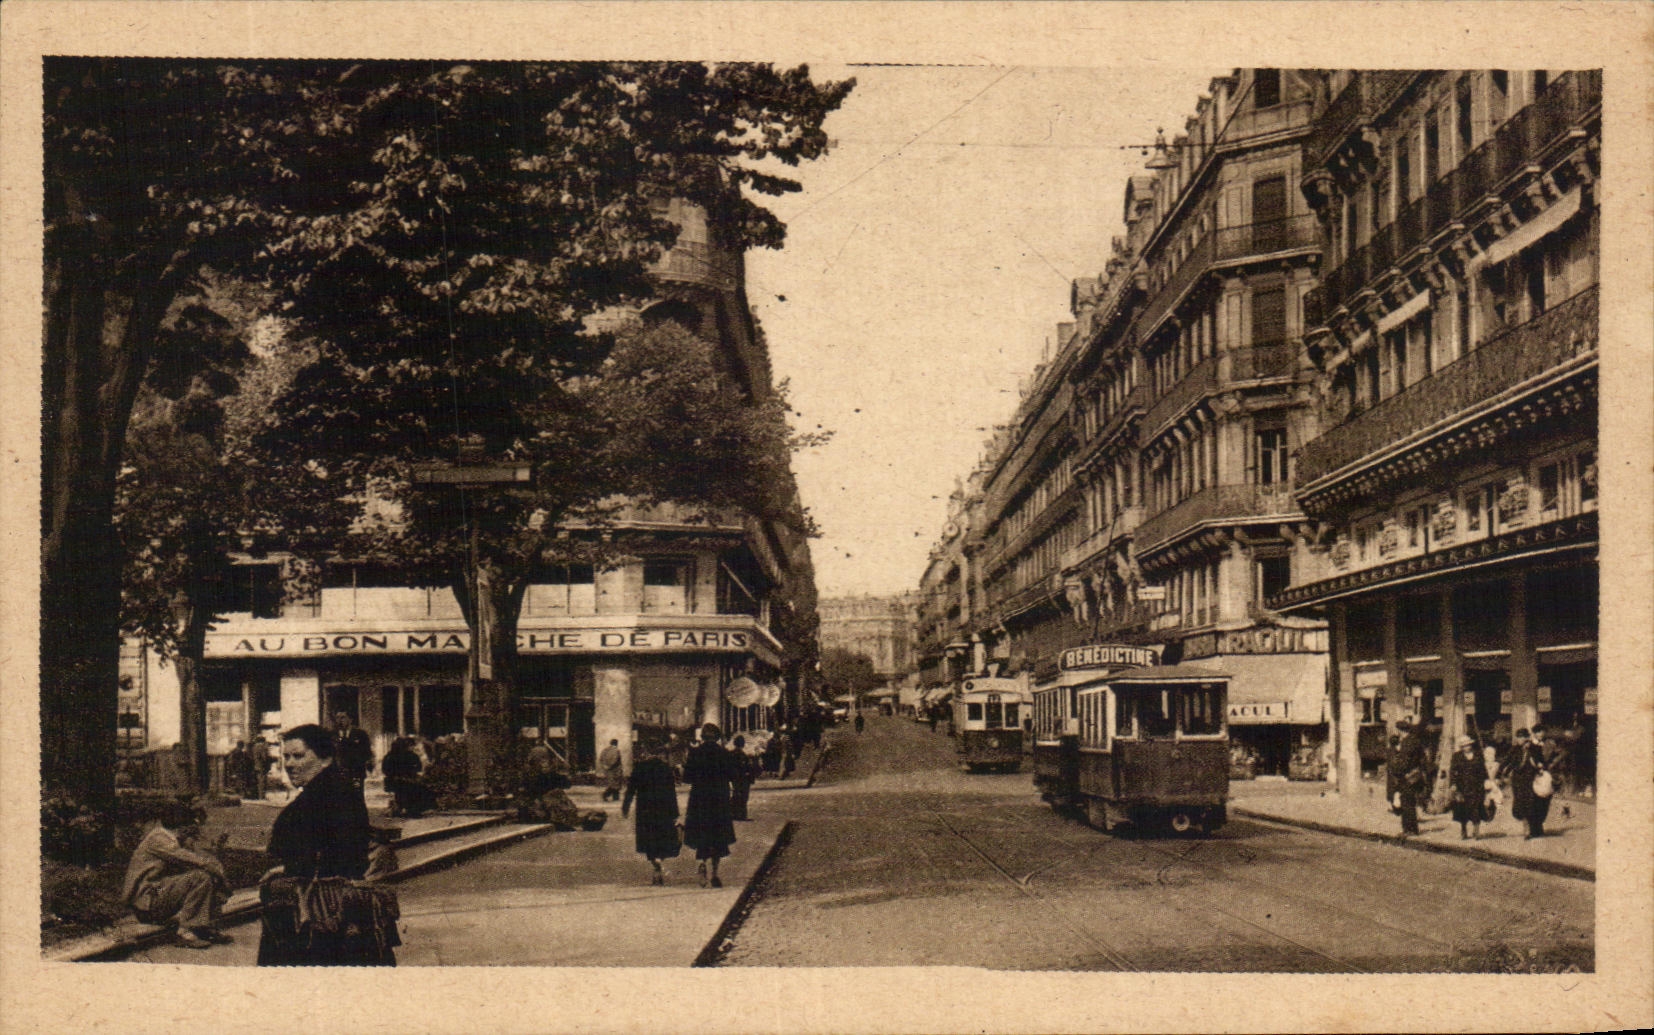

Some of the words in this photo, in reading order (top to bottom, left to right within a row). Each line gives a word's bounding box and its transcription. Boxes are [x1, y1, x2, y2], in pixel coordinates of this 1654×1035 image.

[235, 638, 285, 651] AU
[303, 636, 388, 651] BON
[408, 634, 583, 651] MAHE
[600, 632, 652, 648] DE
[663, 631, 747, 647] PARIS
